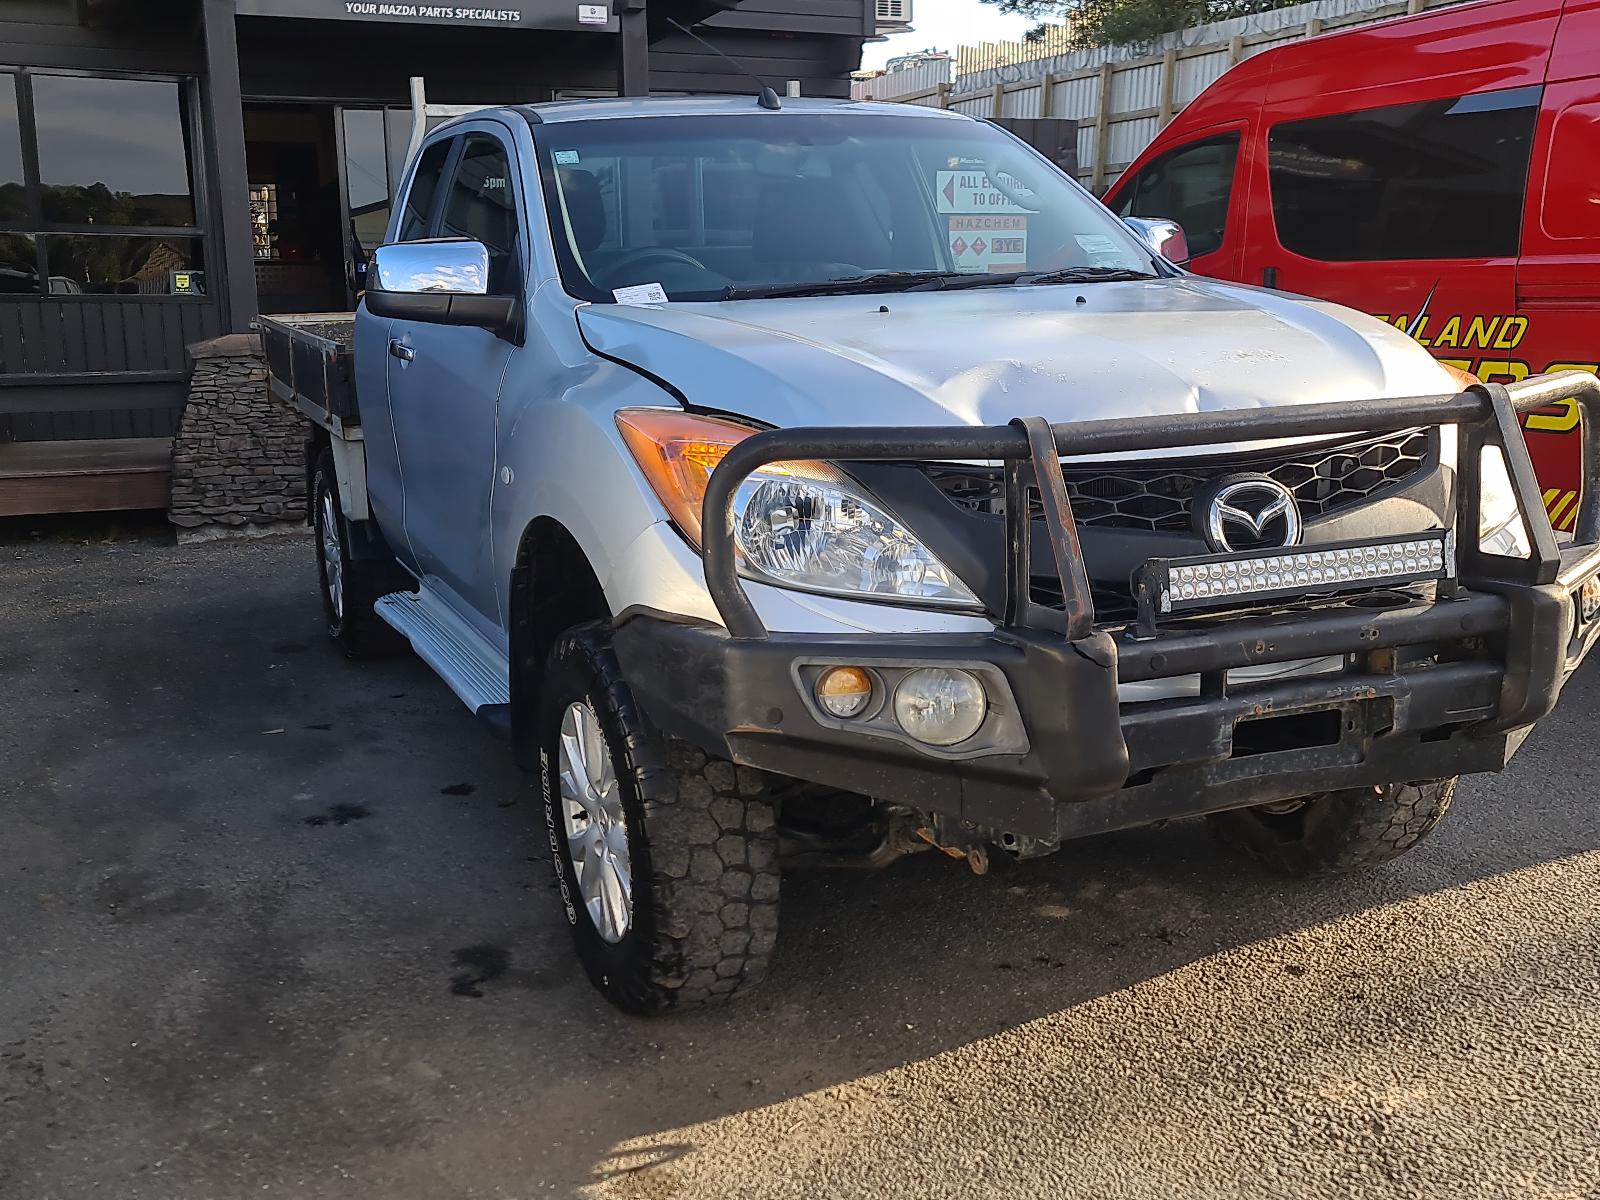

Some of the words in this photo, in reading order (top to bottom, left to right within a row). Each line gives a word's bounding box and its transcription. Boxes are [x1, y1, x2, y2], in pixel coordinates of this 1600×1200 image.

[346, 2, 377, 15] YOUR
[379, 4, 417, 17] MAZDA
[419, 6, 454, 18] PARTS
[456, 8, 521, 21] SPECIALISTS
[960, 176, 978, 189] ALL
[973, 193, 985, 206] TO
[956, 218, 1020, 229] HAZCHEM
[995, 240, 1022, 252] 3YE
[1373, 315, 1530, 350] ALAND
